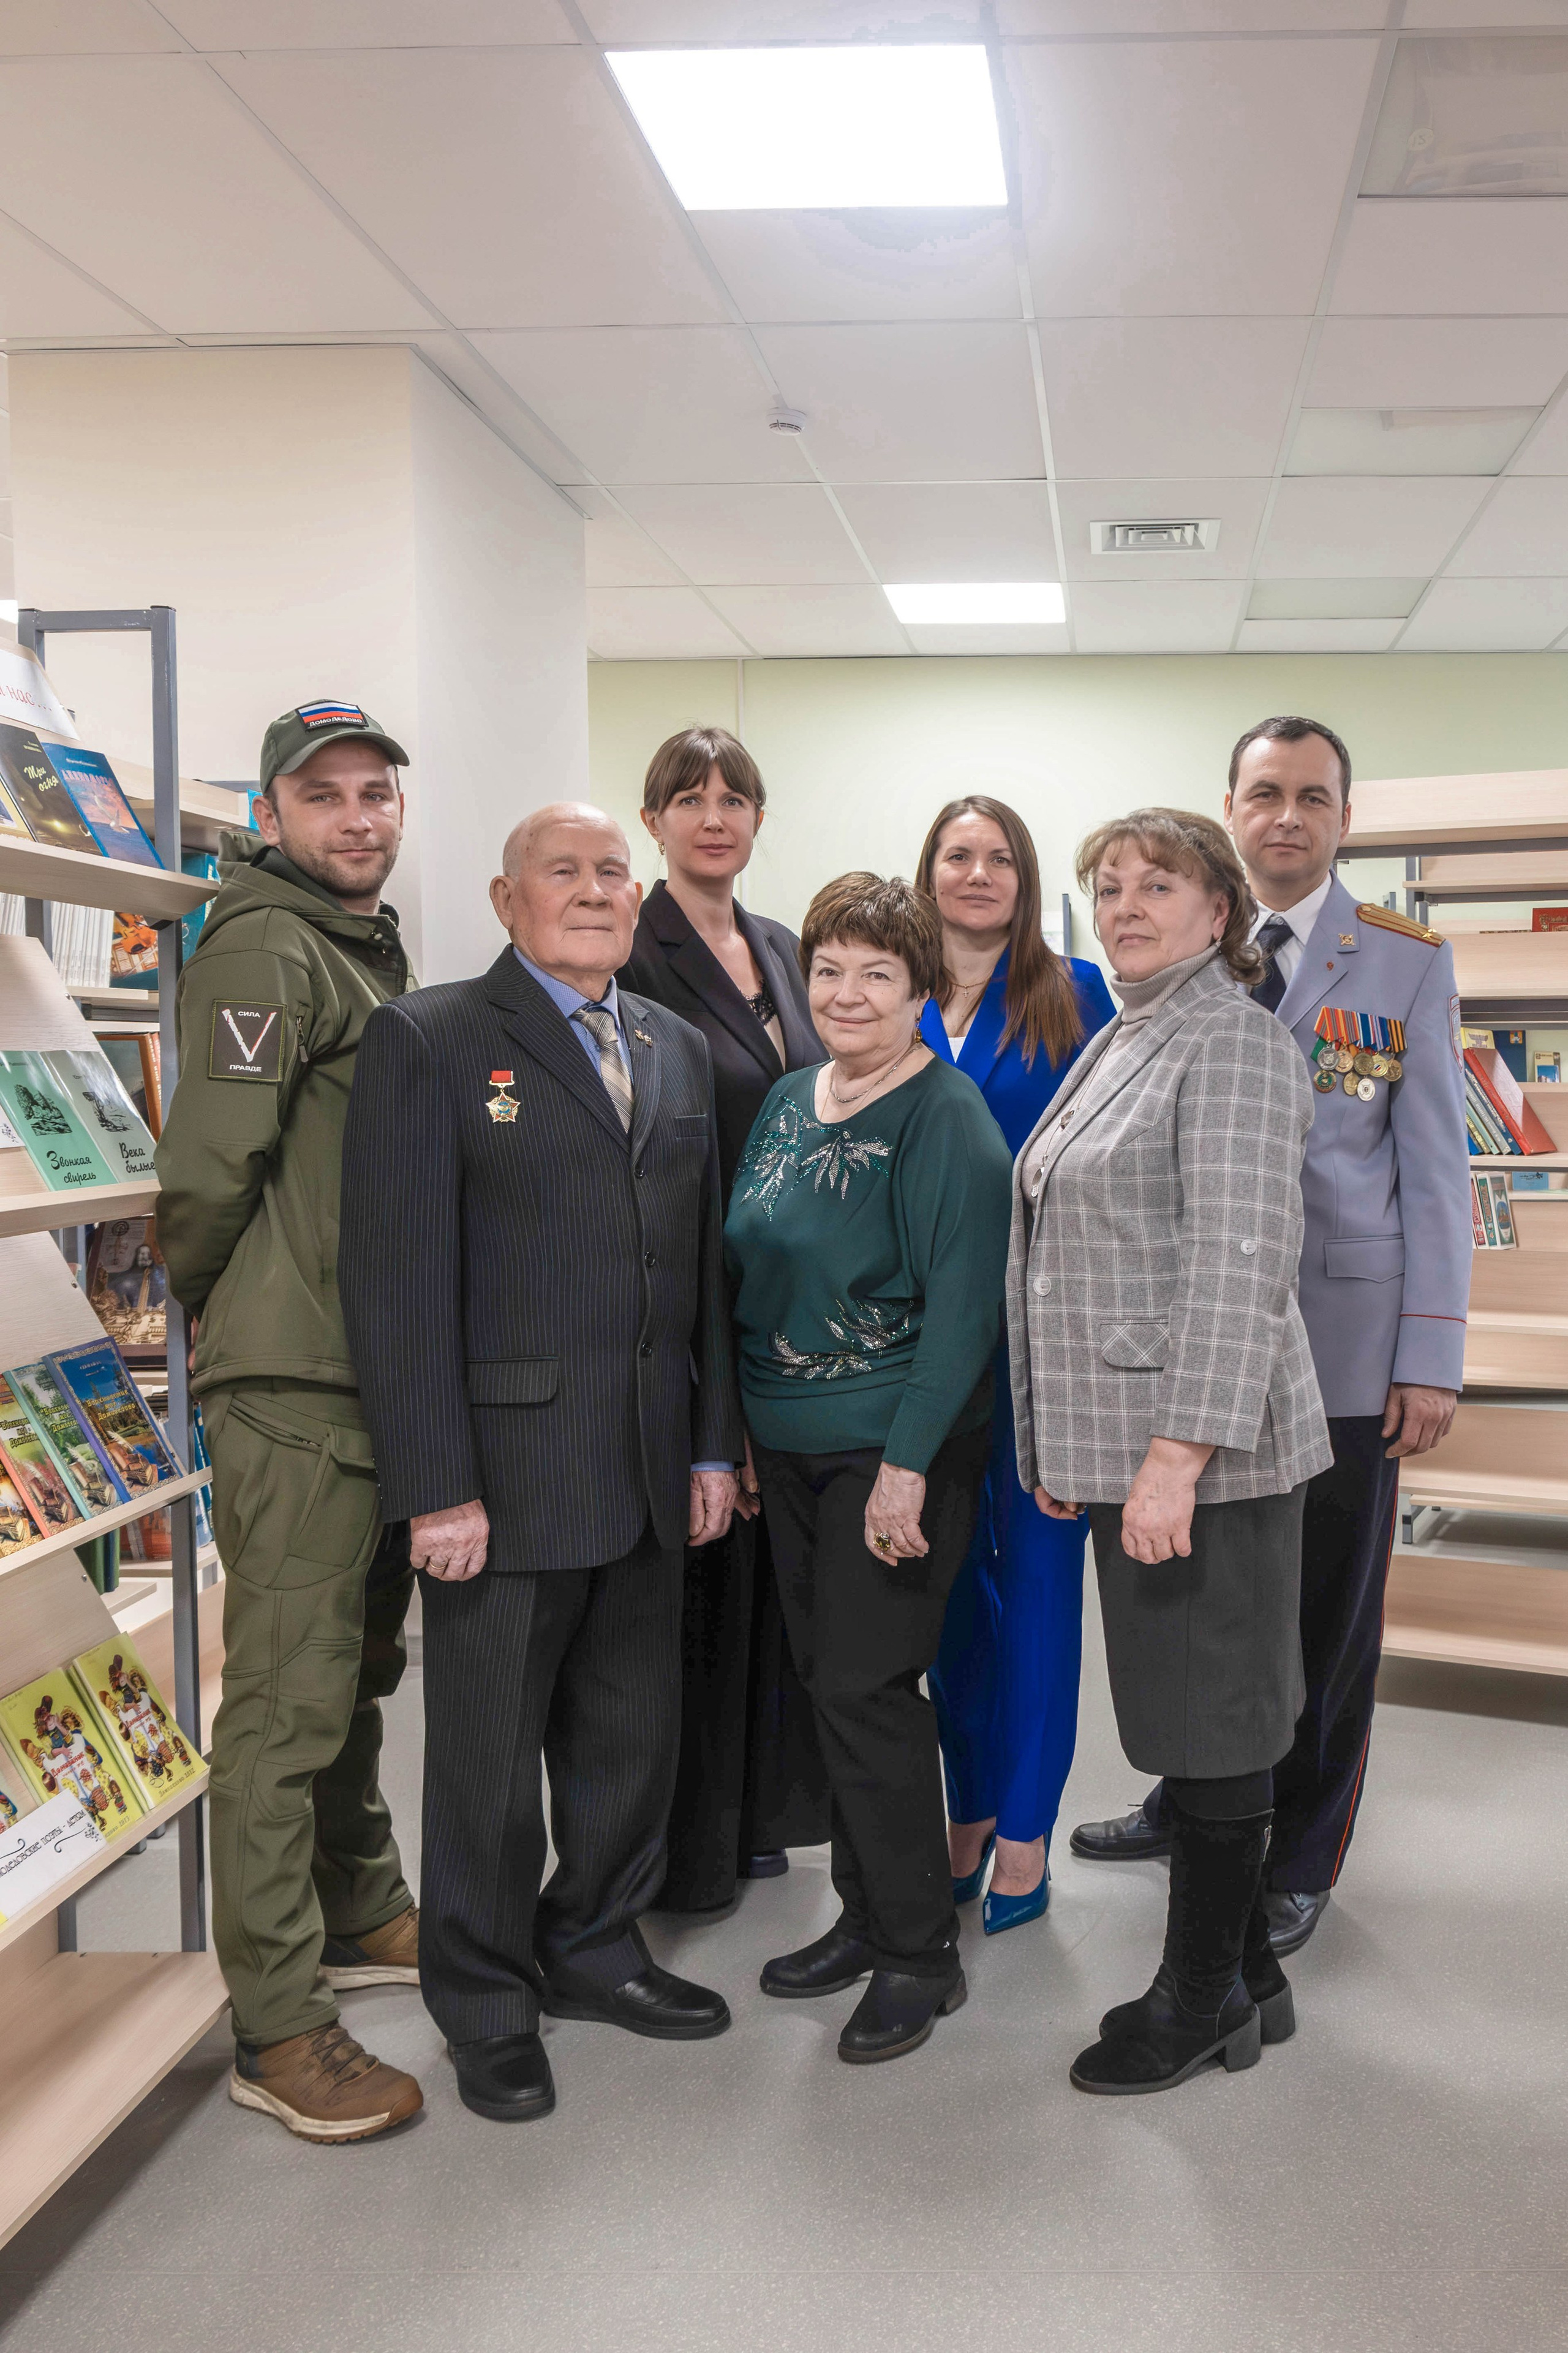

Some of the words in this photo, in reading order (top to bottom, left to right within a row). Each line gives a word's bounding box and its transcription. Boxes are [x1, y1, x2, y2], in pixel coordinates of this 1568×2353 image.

[309, 716, 363, 727] ДОМОДЕДОВО
[222, 1008, 277, 1063] V
[119, 1143, 146, 1159] Века
[47, 1150, 92, 1170] Звонкая
[126, 1160, 156, 1173] былые
[64, 1172, 96, 1185] свирель
